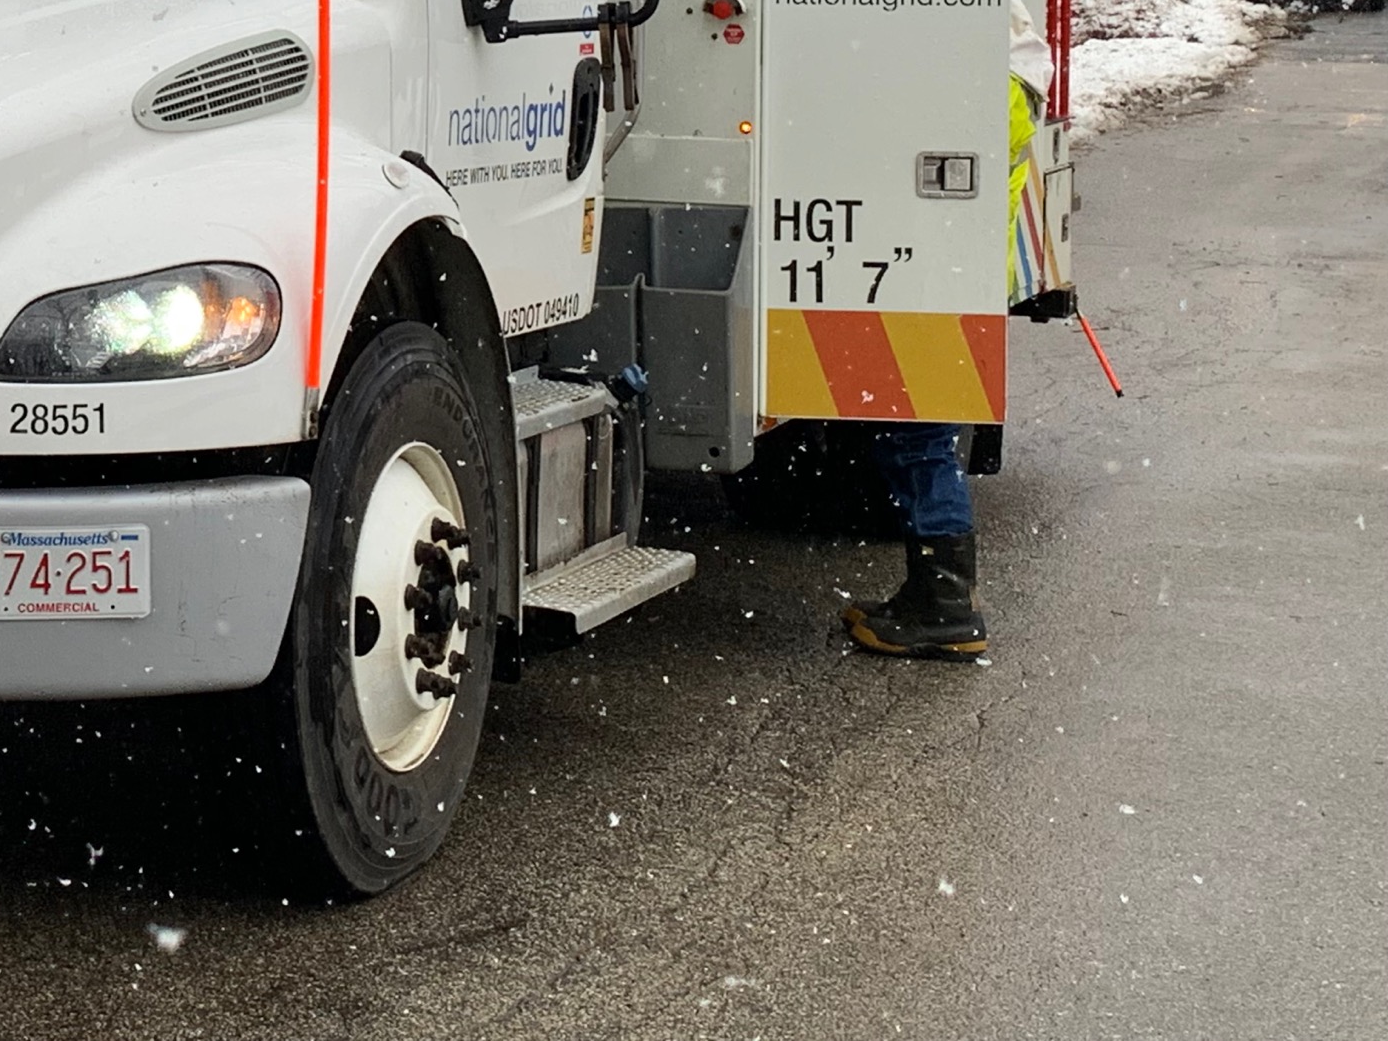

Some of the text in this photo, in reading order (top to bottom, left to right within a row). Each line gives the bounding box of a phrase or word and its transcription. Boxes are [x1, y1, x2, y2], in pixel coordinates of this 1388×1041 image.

[448, 82, 567, 151] nationalgrid
[446, 167, 469, 187] HERE
[470, 165, 490, 185] WITH
[510, 161, 530, 180] HERE
[532, 159, 547, 178] FOR
[773, 198, 863, 243] HGT
[502, 293, 579, 335] USDOT 049410
[9, 402, 106, 435] 28551
[9, 532, 108, 547] Massachusetts
[17, 602, 100, 614] COMMERCIAL
